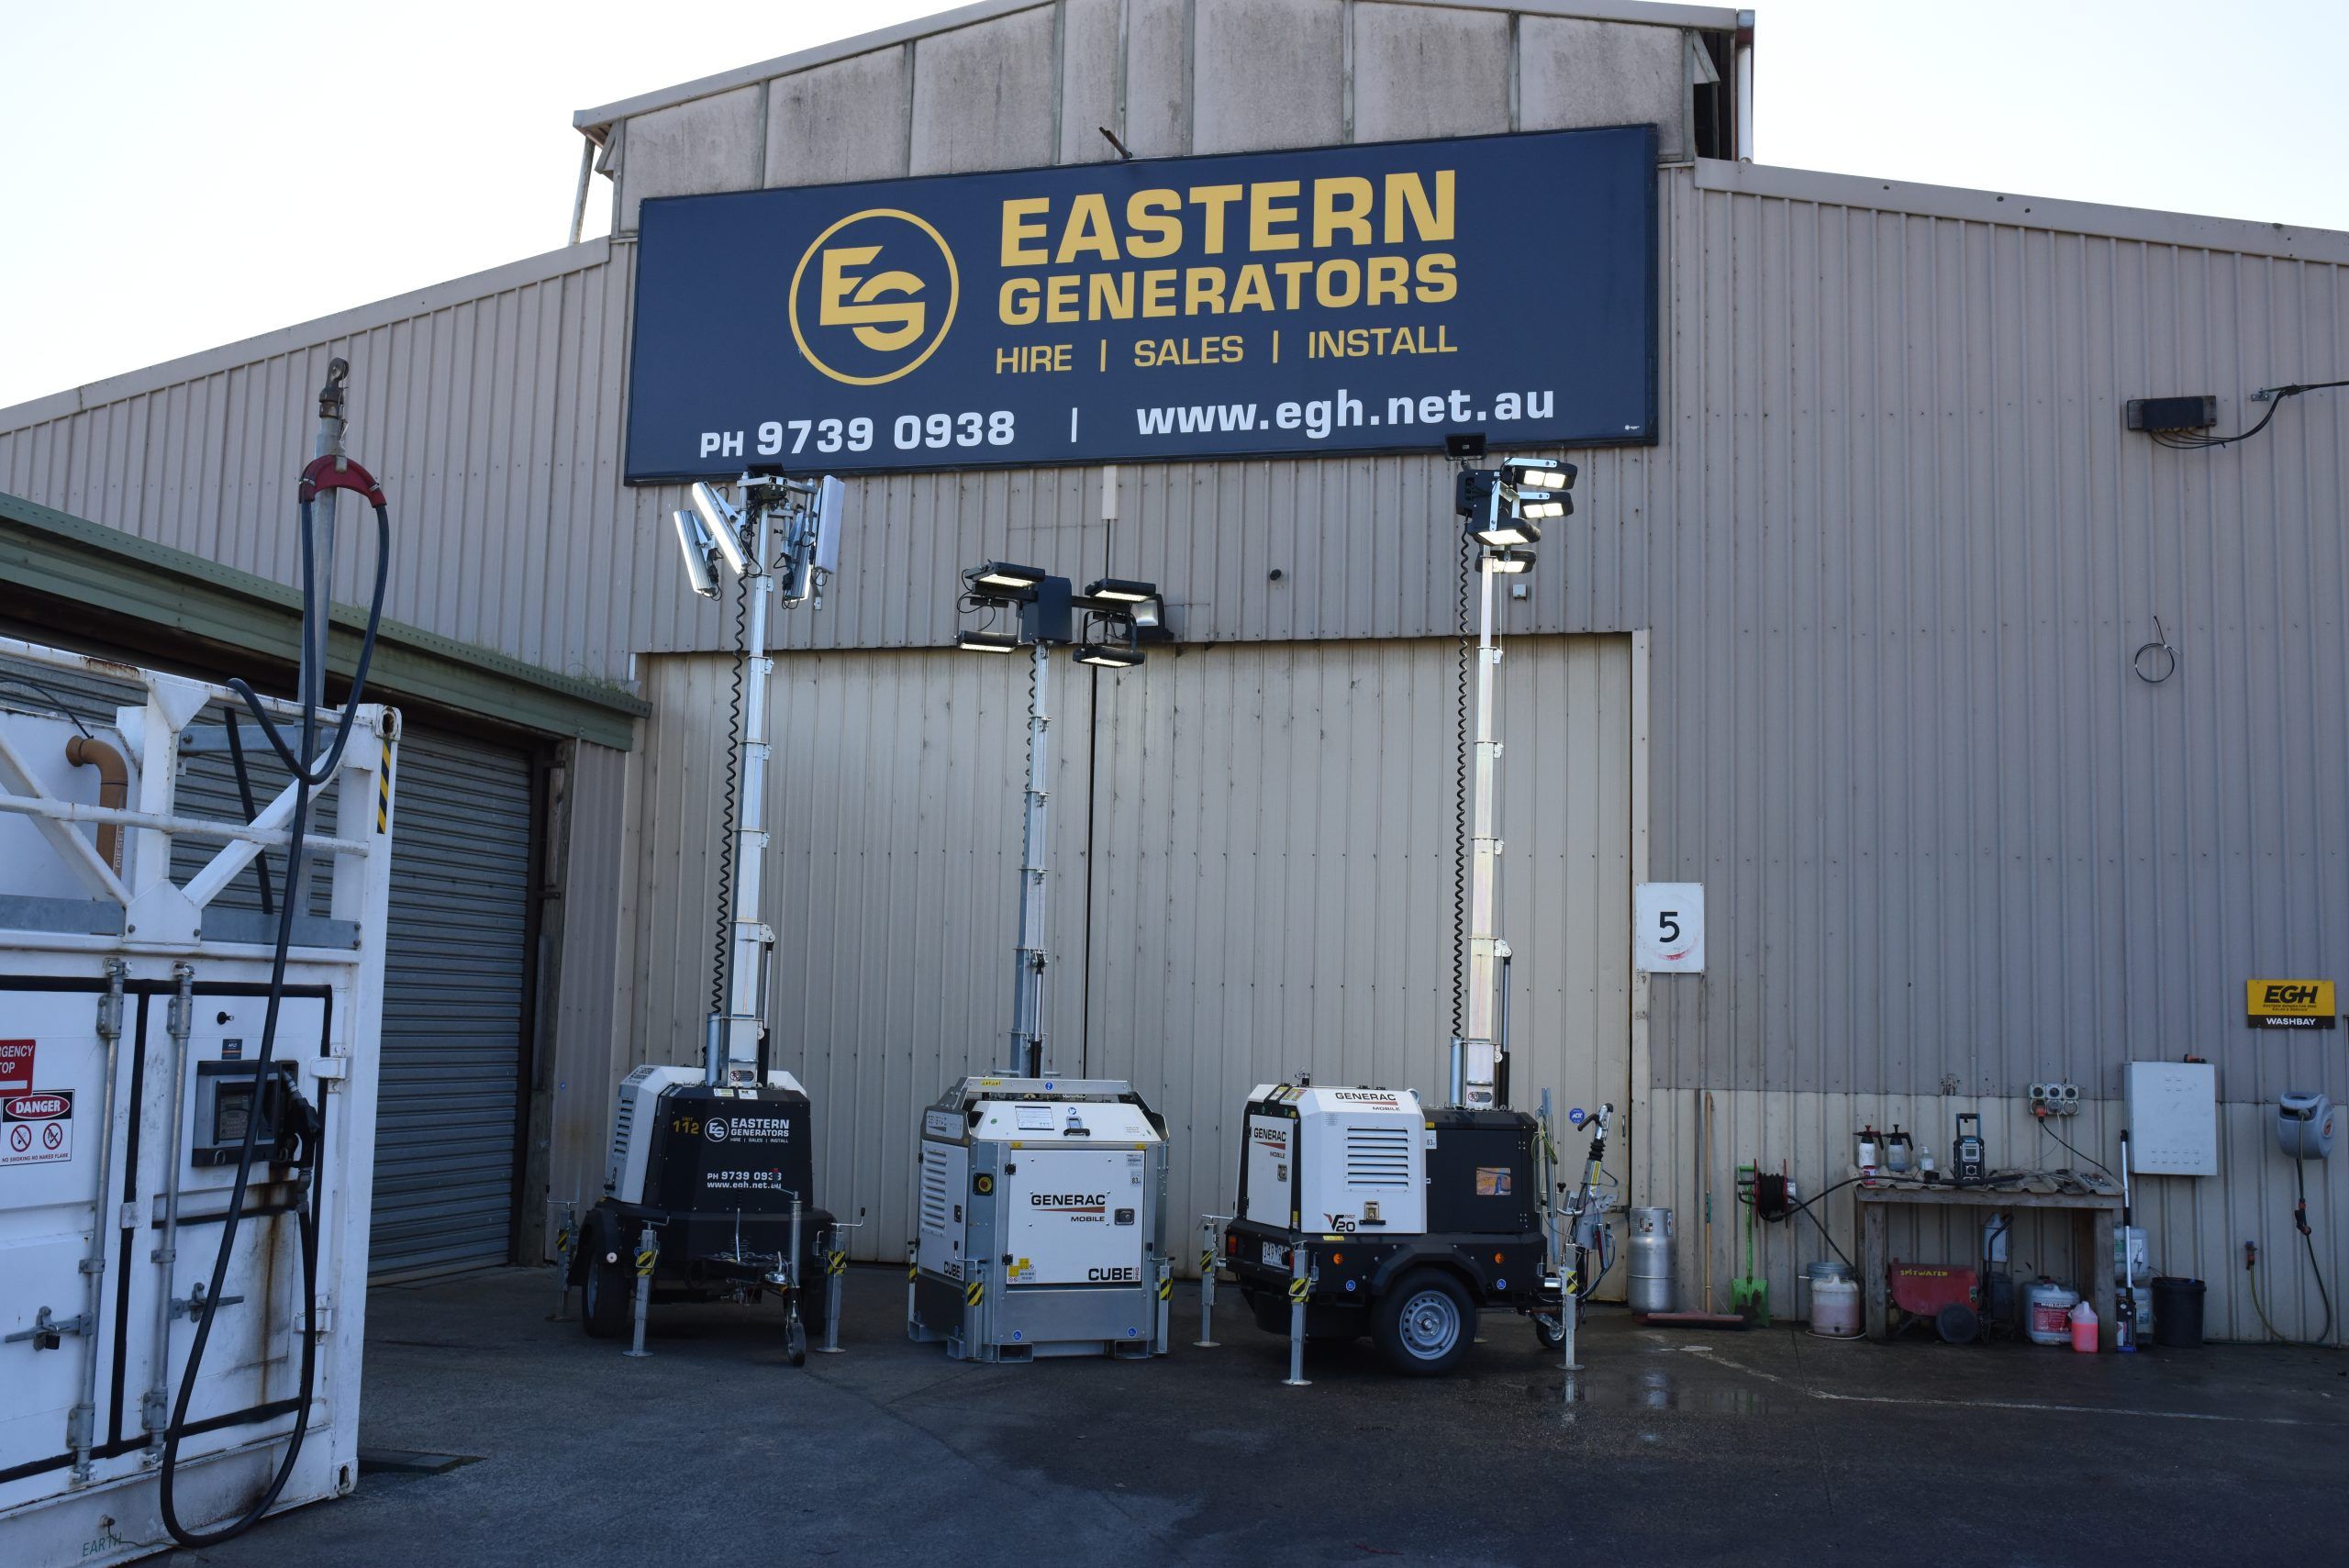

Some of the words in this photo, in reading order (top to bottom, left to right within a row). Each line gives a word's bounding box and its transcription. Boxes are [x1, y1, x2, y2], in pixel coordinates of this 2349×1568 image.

[1001, 170, 1456, 267] EASTERN
[998, 252, 1458, 326] GENERATORS
[996, 344, 1073, 374] HIRE
[1133, 335, 1244, 367] SALES
[1308, 325, 1458, 359] INSTALL
[699, 430, 744, 458] PH
[757, 417, 874, 455] 9739
[894, 410, 1015, 450] 0938
[1136, 389, 1554, 439] www.egh.net.au
[1659, 911, 1680, 943] 5
[2264, 985, 2319, 1004] EGH
[2266, 1018, 2316, 1026] WASHBAY
[1335, 1092, 1397, 1101] GENERAC
[16, 1100, 61, 1114] DANGER
[673, 1120, 700, 1134] 112
[730, 1118, 790, 1129] EASTERN
[730, 1129, 789, 1137] GENERATORS
[1253, 1128, 1286, 1142] GENERAC
[721, 1172, 750, 1181] 9739
[1030, 1195, 1106, 1206] GENERAC
[944, 1261, 962, 1279] CUBE
[1088, 1267, 1133, 1281] CUBE
[82, 1532, 122, 1557] EARTH
